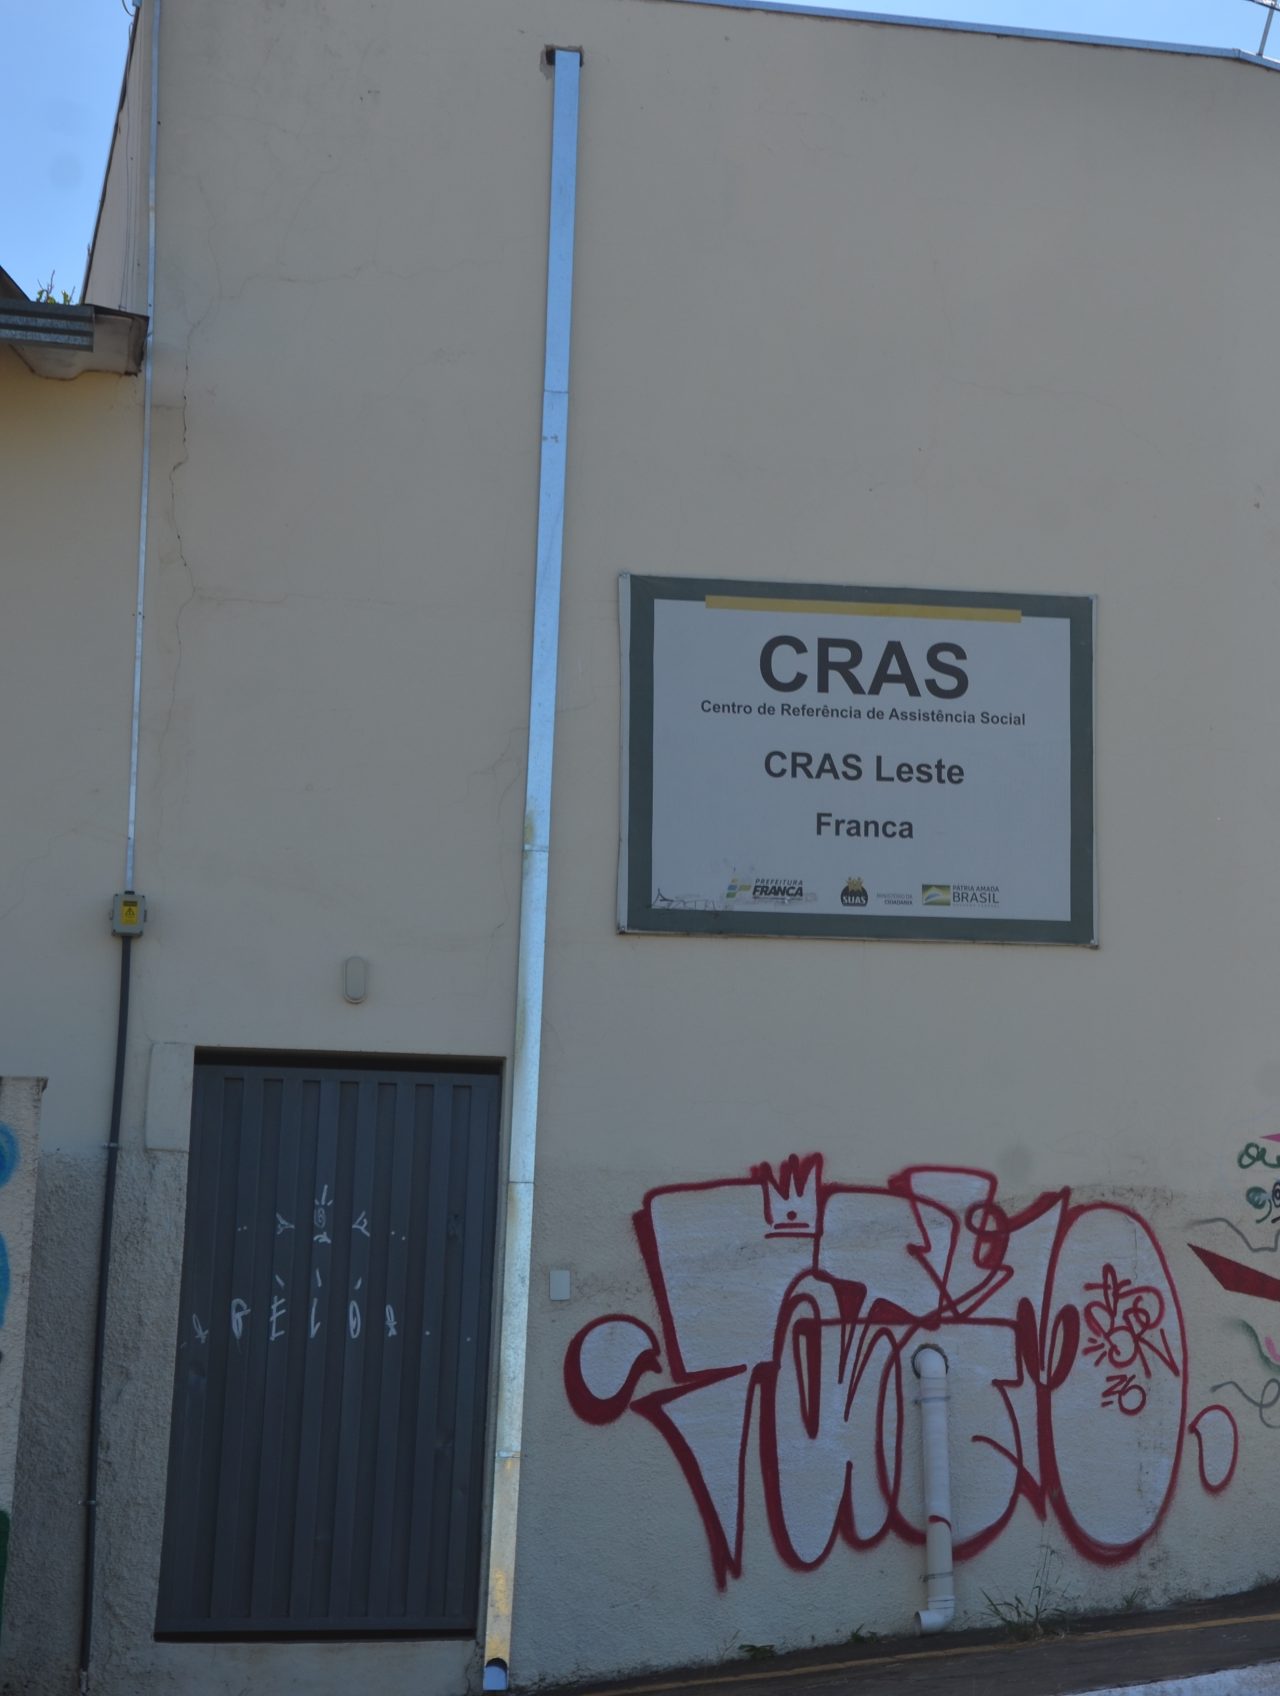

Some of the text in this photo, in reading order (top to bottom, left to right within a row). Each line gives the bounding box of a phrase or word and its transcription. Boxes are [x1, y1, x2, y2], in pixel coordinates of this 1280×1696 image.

[759, 634, 969, 700] CRAS
[700, 700, 1026, 726] Centro de Referência de Assistência Social
[764, 750, 965, 785] CRAS Leste
[815, 812, 914, 839] Franca
[755, 878, 803, 886] PREFEITURA
[752, 885, 804, 897] FRANCA
[976, 885, 1000, 893] AMADA
[841, 895, 867, 905] SUAS
[953, 892, 1000, 904] BRASIL
